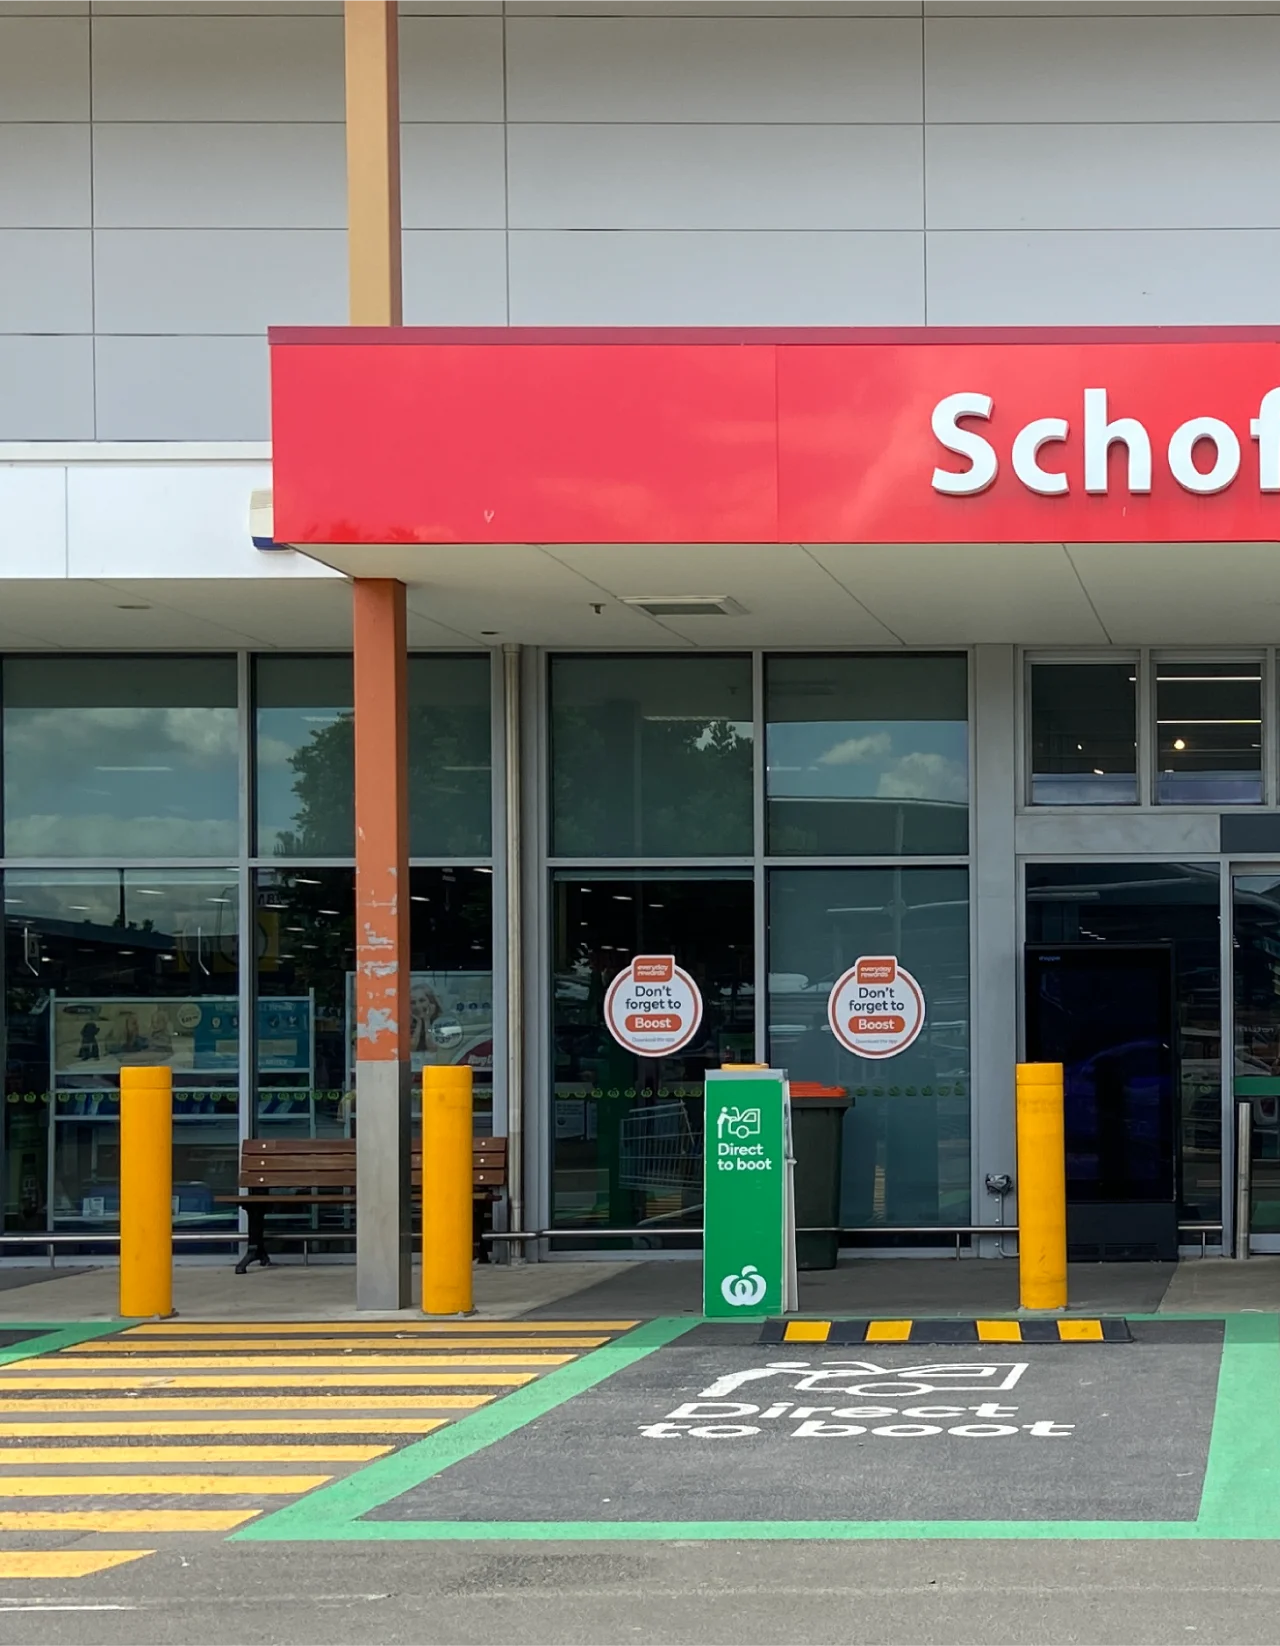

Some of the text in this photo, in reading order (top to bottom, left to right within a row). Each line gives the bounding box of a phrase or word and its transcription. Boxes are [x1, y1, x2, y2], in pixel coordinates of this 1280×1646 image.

[637, 964, 669, 972] everyday
[635, 986, 672, 997] Don't
[859, 987, 895, 998] Don't
[626, 998, 682, 1012] forget to
[849, 1000, 904, 1014] forget to
[635, 1017, 672, 1028] Boost
[858, 1019, 895, 1030] Boost
[718, 1143, 764, 1156] Direct
[717, 1157, 772, 1170] to boot
[664, 1402, 1019, 1420] Direct
[637, 1420, 1077, 1438] to boot
